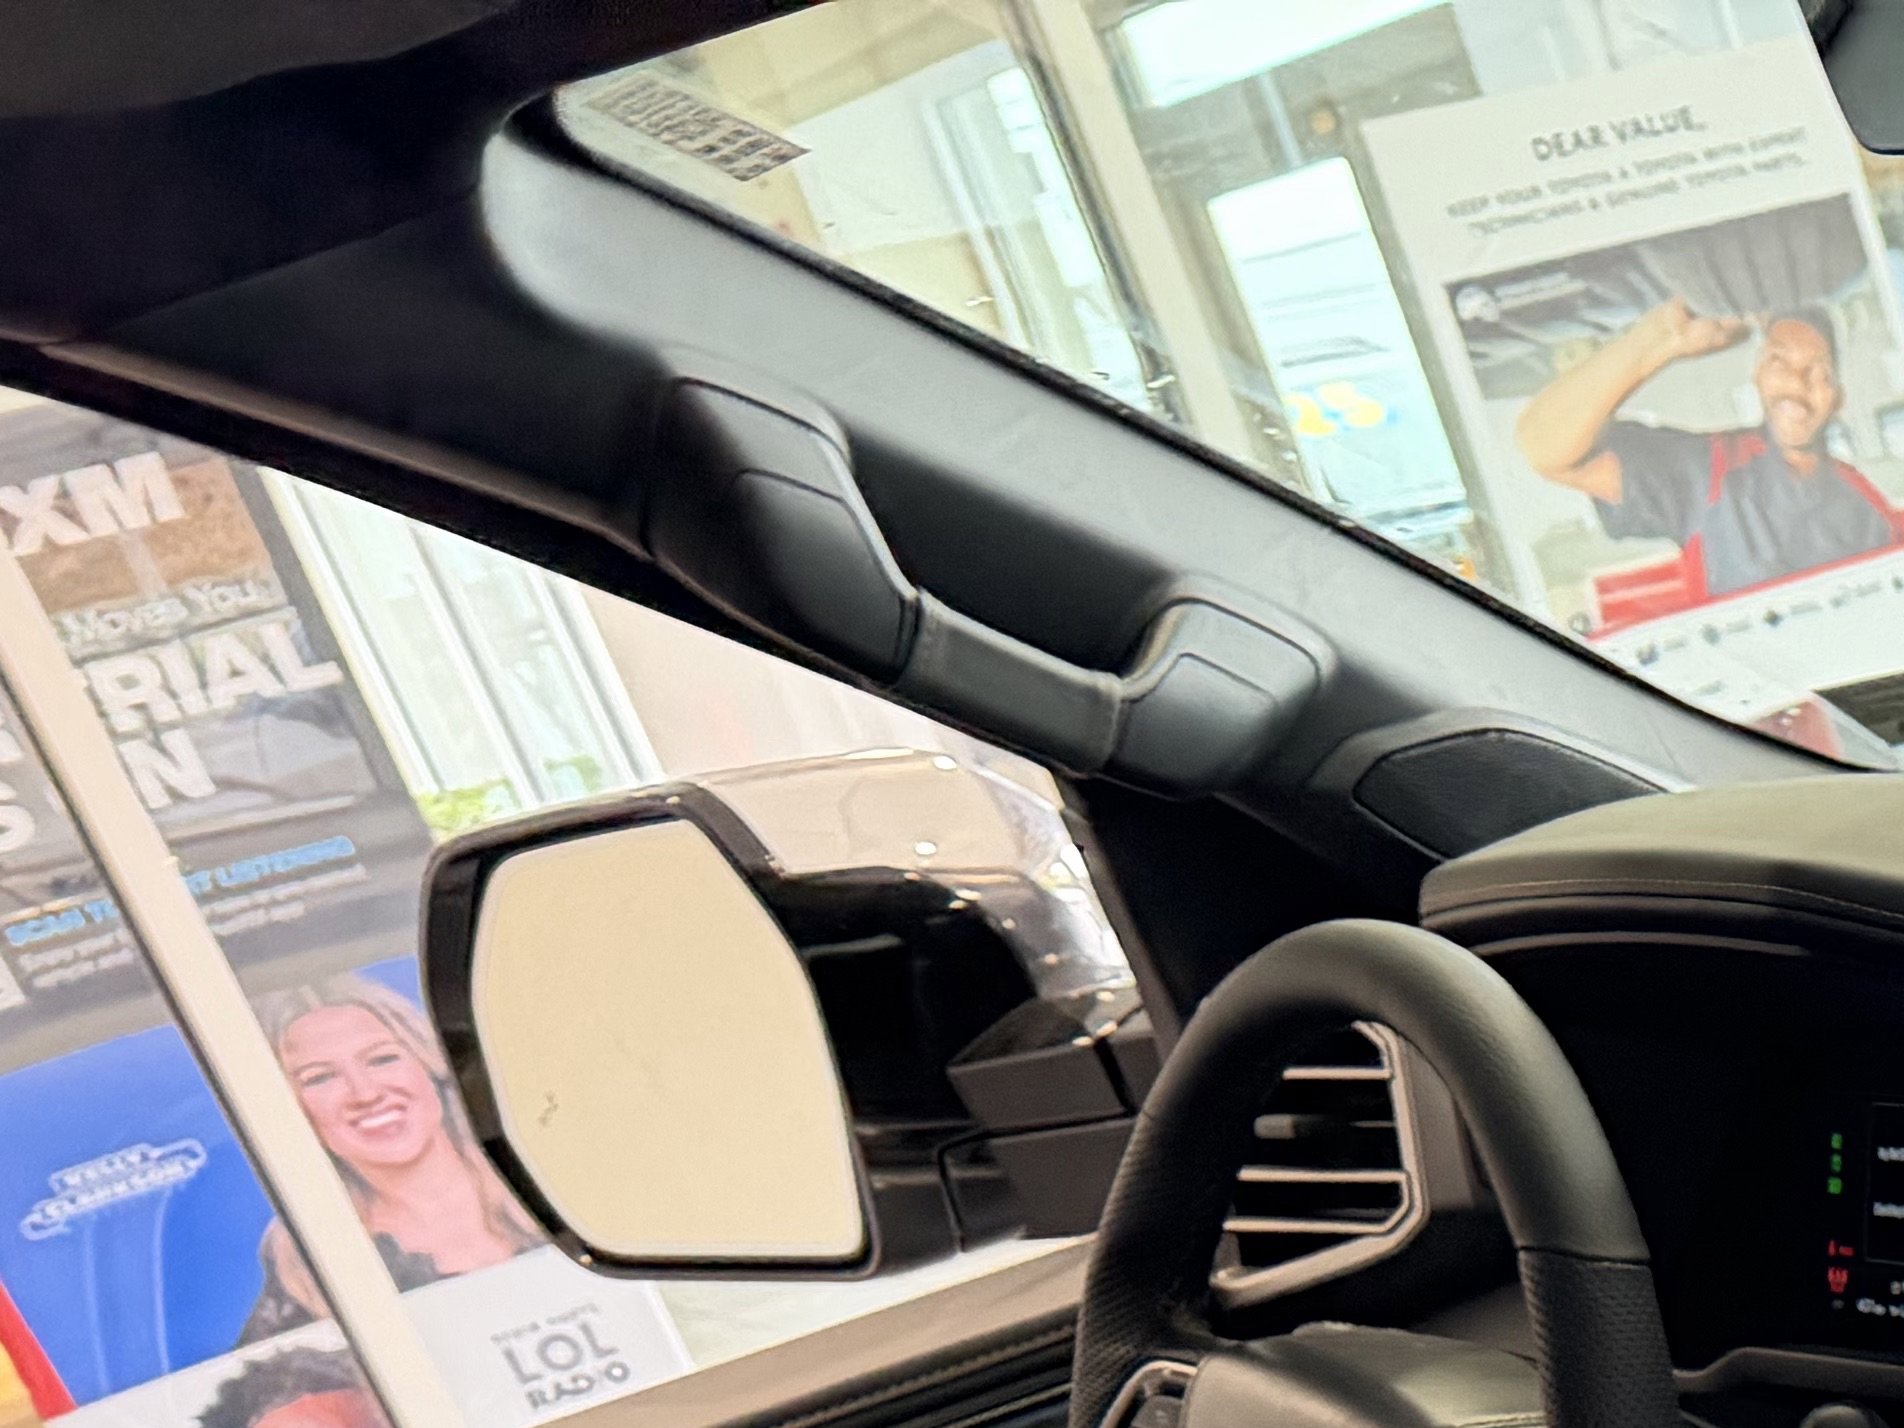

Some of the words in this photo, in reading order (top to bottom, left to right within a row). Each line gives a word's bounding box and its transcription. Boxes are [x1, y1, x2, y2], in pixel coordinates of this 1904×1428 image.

[1531, 123, 1608, 161] DEAR
[80, 619, 344, 734] RIAL
[117, 726, 216, 810] N
[502, 1319, 620, 1384] LOL
